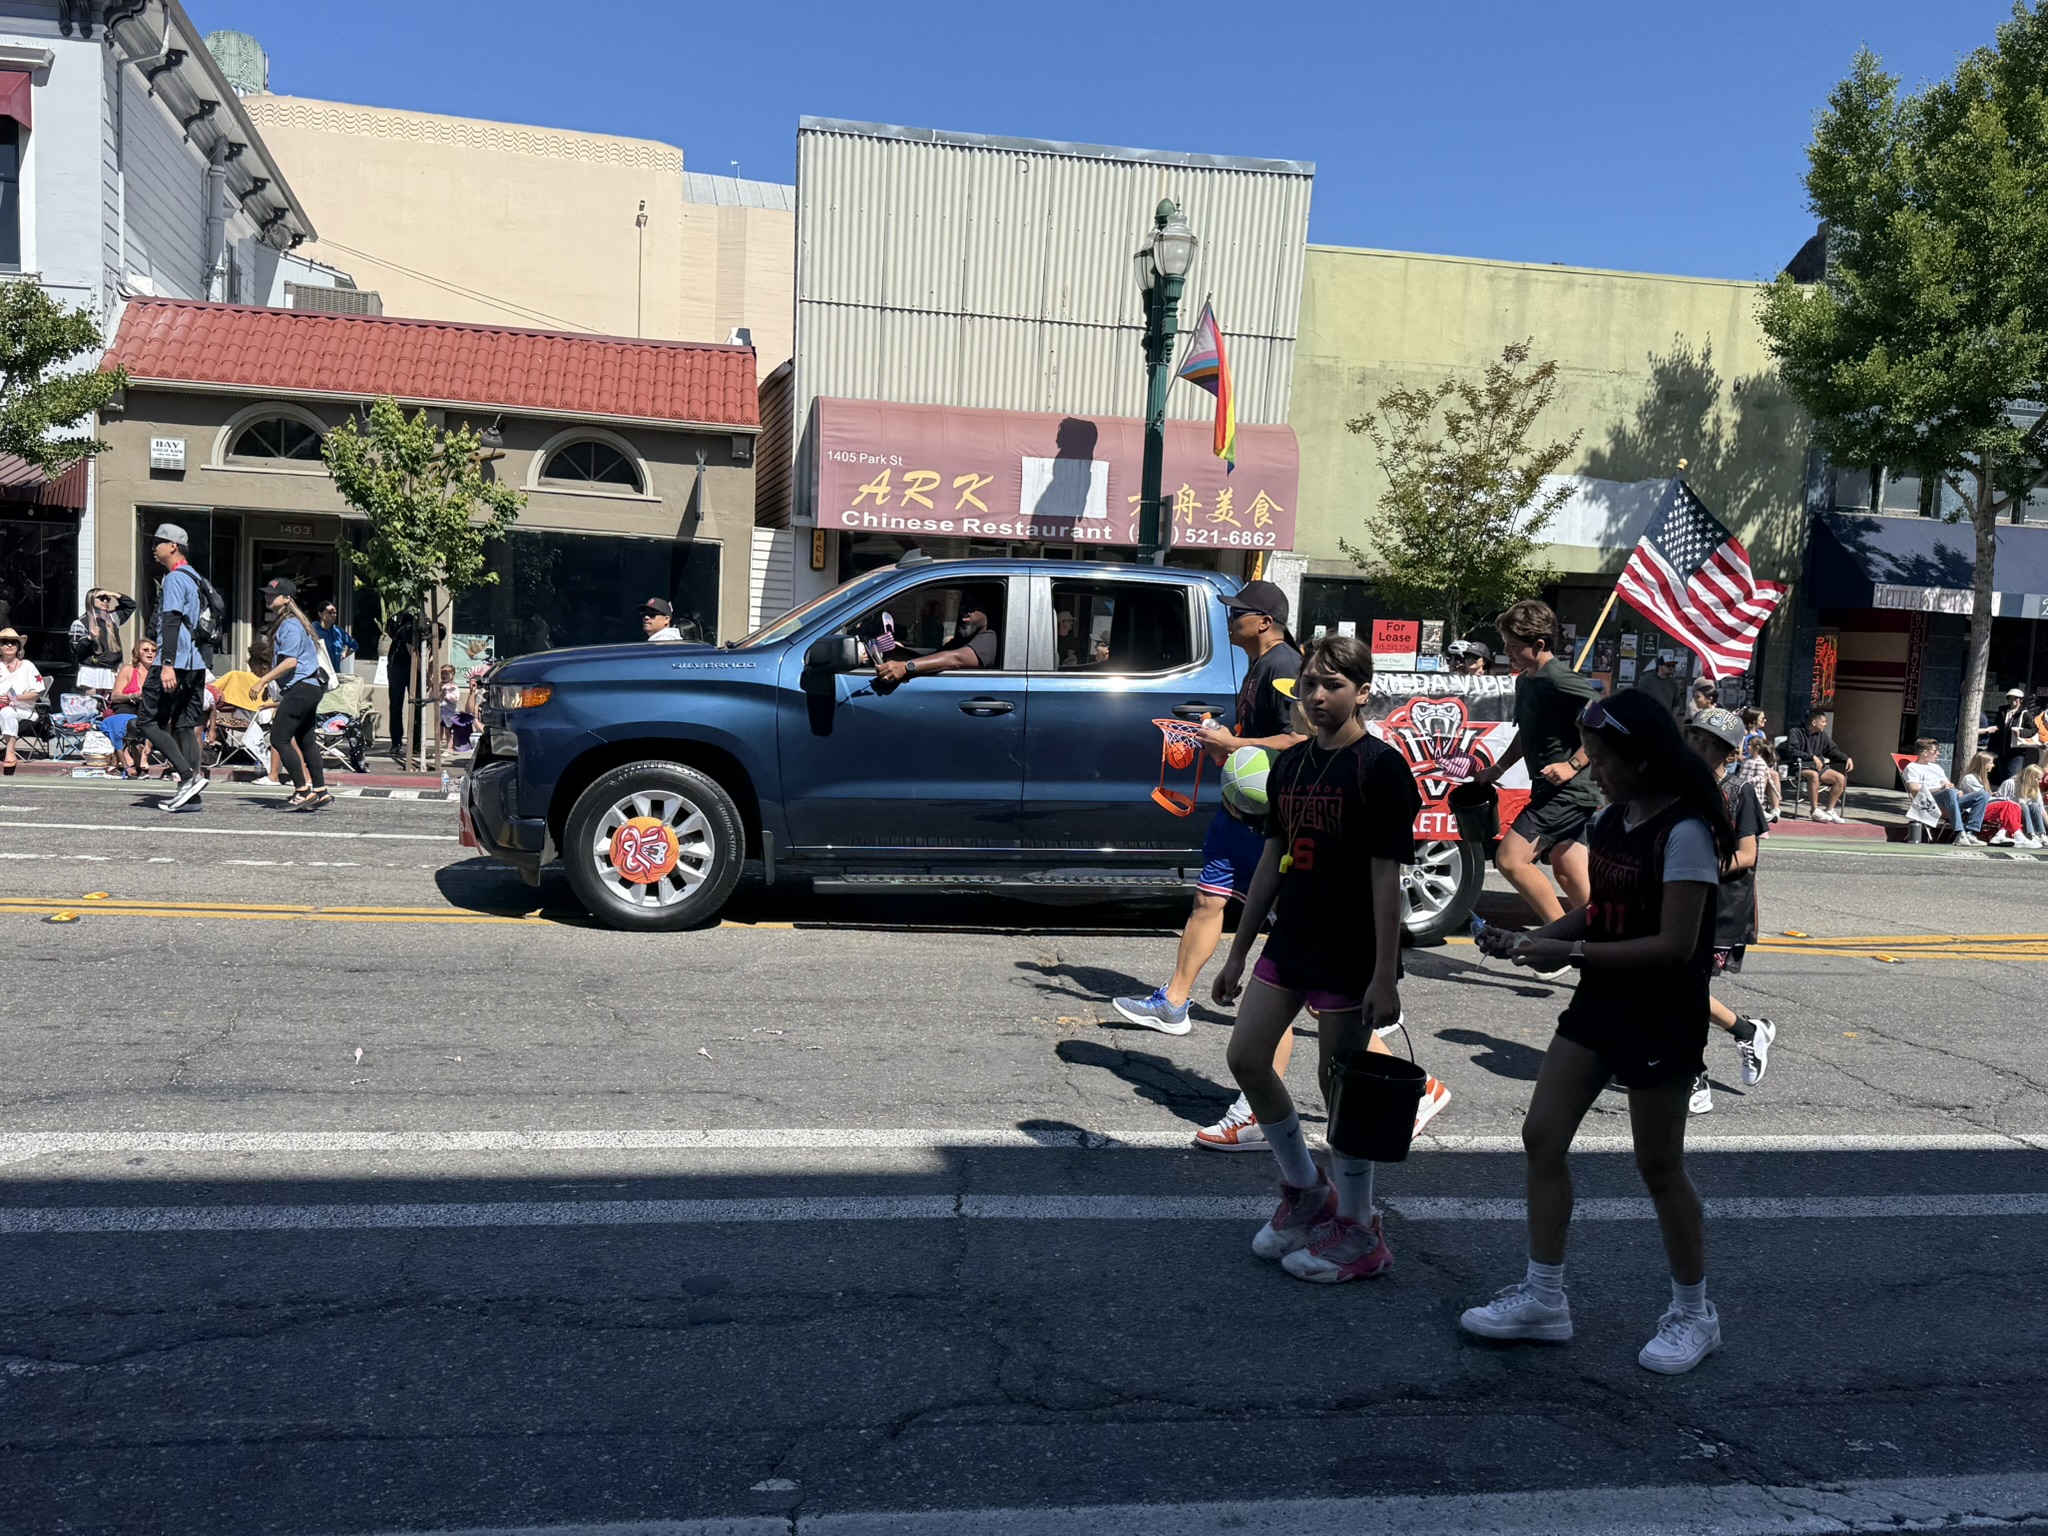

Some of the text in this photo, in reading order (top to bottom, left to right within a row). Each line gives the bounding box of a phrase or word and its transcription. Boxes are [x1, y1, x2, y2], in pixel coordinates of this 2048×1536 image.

[156, 440, 180, 448] BAY
[827, 450, 903, 466] 1405 Park St
[851, 468, 994, 513] ARK
[280, 525, 311, 536] 1403
[841, 510, 955, 532] Chinese
[962, 518, 1113, 540] Restaurant
[1185, 528, 1276, 547] 521-6862
[1386, 621, 1406, 632] For
[1379, 631, 1411, 642] Lease
[671, 661, 757, 670] SILVERADO
[1370, 672, 1516, 696] MEDA VIPE
[1293, 837, 1316, 870] 6
